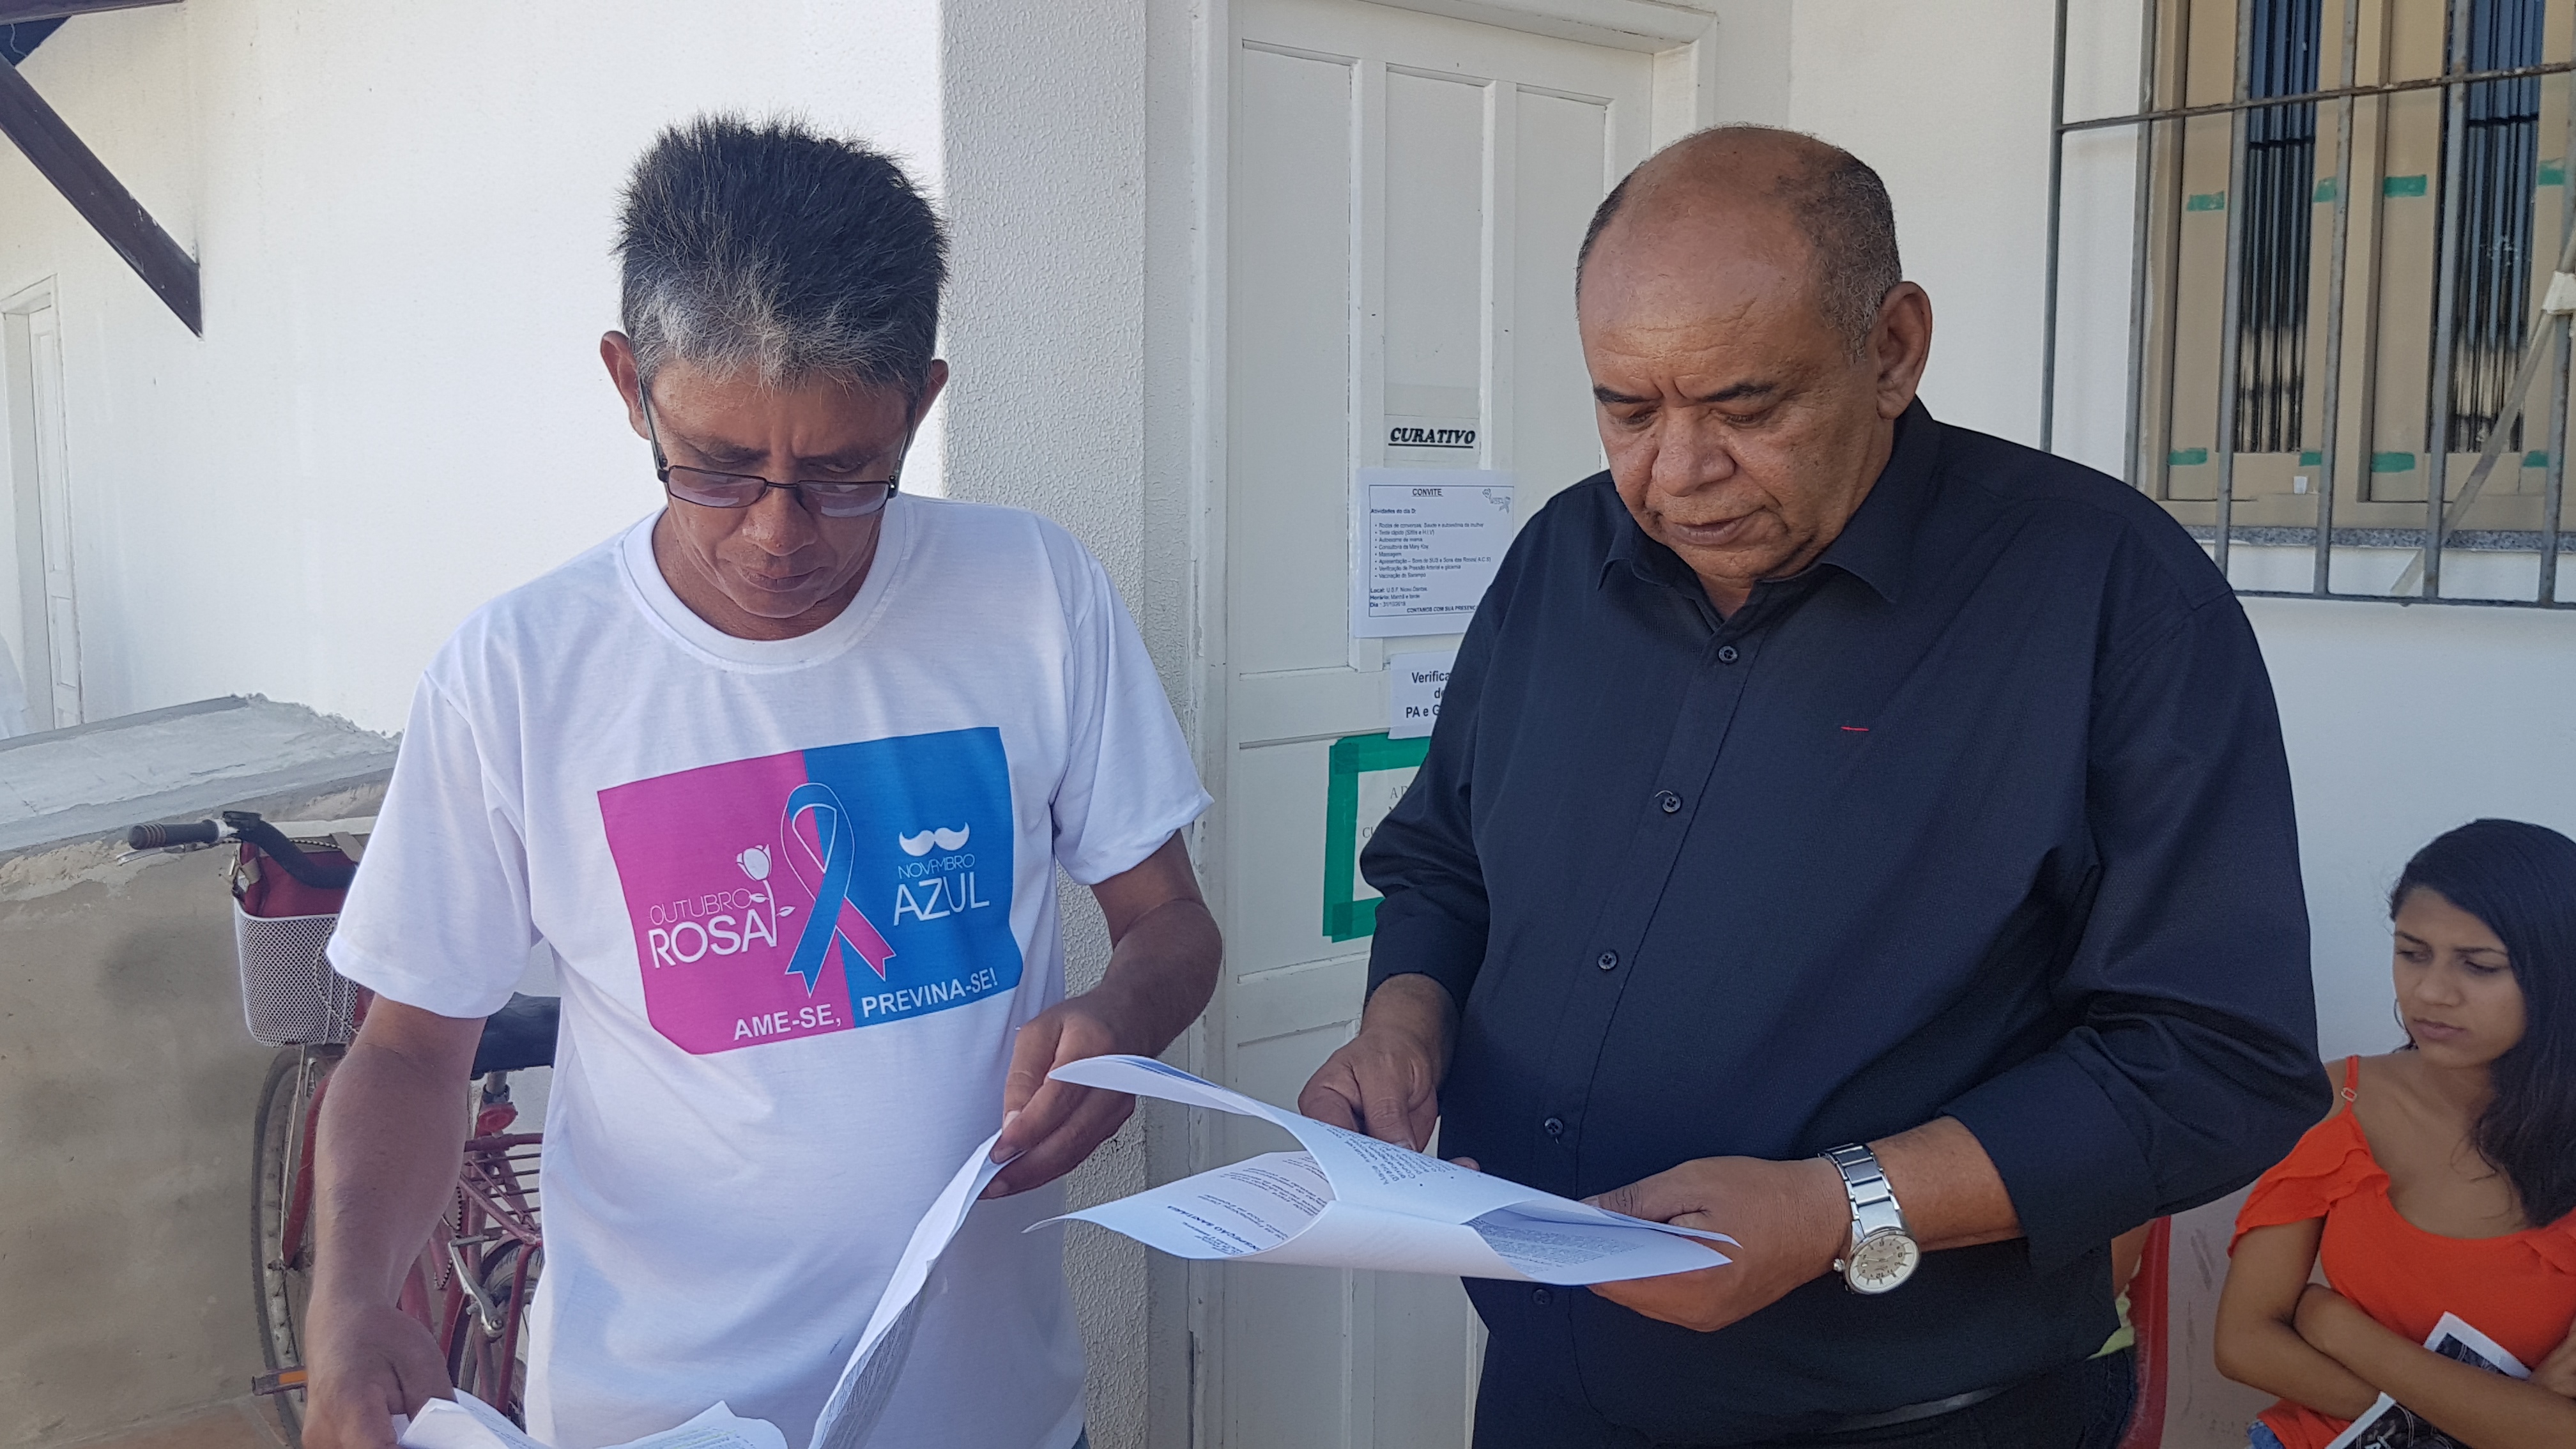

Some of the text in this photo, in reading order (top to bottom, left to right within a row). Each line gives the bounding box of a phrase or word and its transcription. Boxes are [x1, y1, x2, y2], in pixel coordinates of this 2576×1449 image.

[1389, 427, 1476, 445] CURATIVO
[1412, 488, 1443, 496] CONVITE
[1411, 670, 1451, 684] Verifica
[1406, 706, 1420, 718] PA
[1423, 708, 1429, 717] e
[650, 887, 753, 926] OUTUBRO
[893, 871, 990, 926] AZUL
[648, 908, 778, 969] ROSA
[733, 967, 999, 1041] AME-SE, PREVINA-SE!
